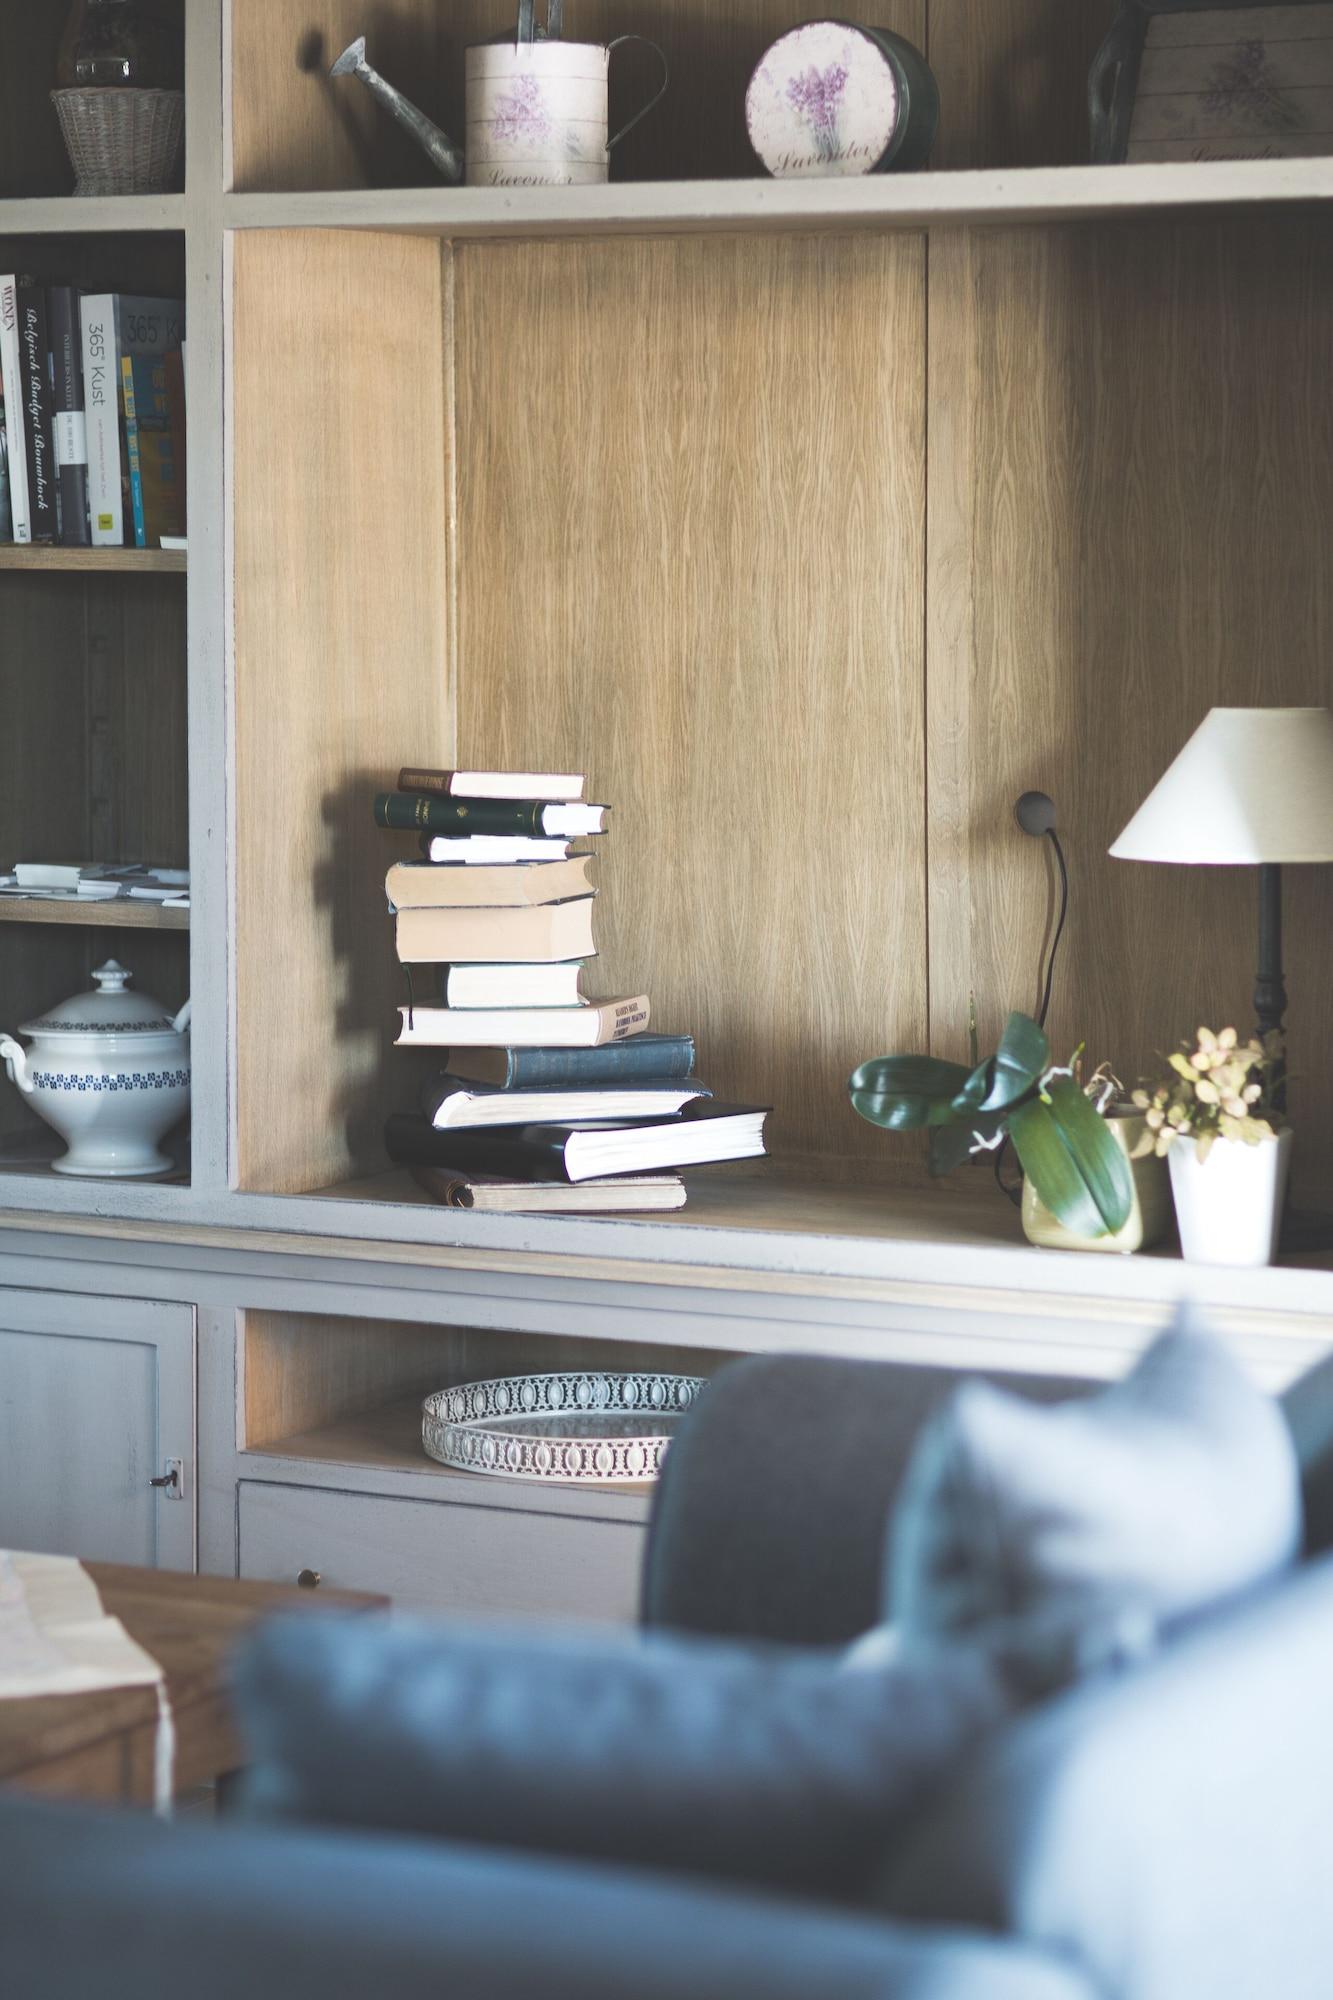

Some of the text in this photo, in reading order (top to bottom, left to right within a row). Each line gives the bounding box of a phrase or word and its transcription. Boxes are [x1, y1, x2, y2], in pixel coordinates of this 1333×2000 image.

[772, 142, 874, 173] Lavender
[90, 366, 107, 407] Kust
[25, 308, 50, 510] Belgisch Budget Bouwboek
